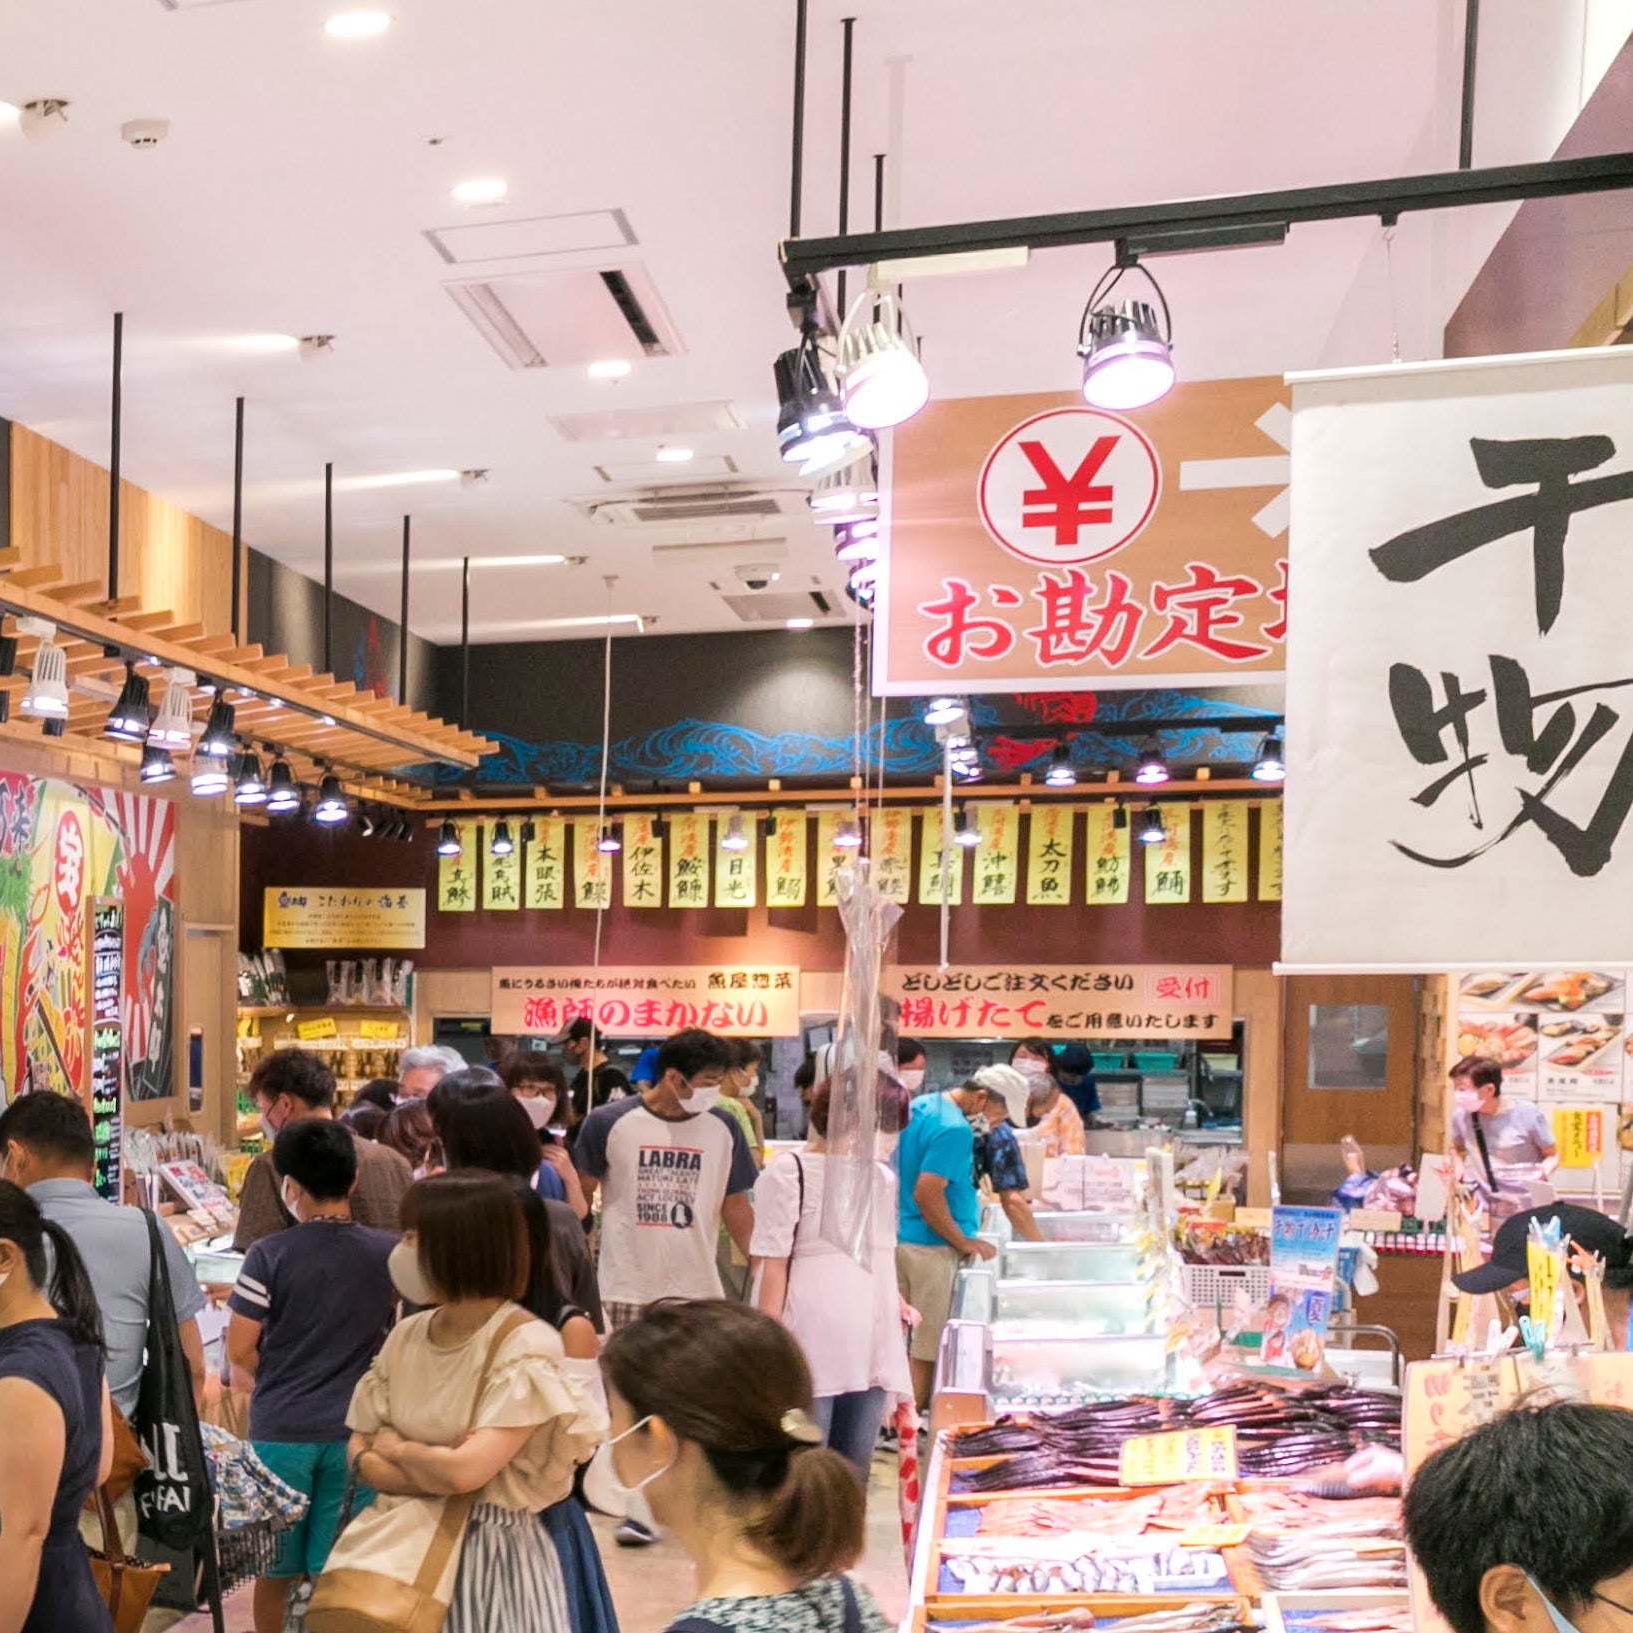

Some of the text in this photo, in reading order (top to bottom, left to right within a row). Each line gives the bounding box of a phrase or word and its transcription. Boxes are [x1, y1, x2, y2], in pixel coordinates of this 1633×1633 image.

[918, 564, 1289, 670] お勘定
[1369, 434, 1633, 878] 干物
[628, 846, 656, 901] 伊佐木
[1033, 836, 1067, 900] 太刀魚
[523, 995, 769, 1030] 漁師のまかない
[901, 971, 1211, 999] どしどしご注文ください 受付
[638, 1149, 702, 1171] LABRA
